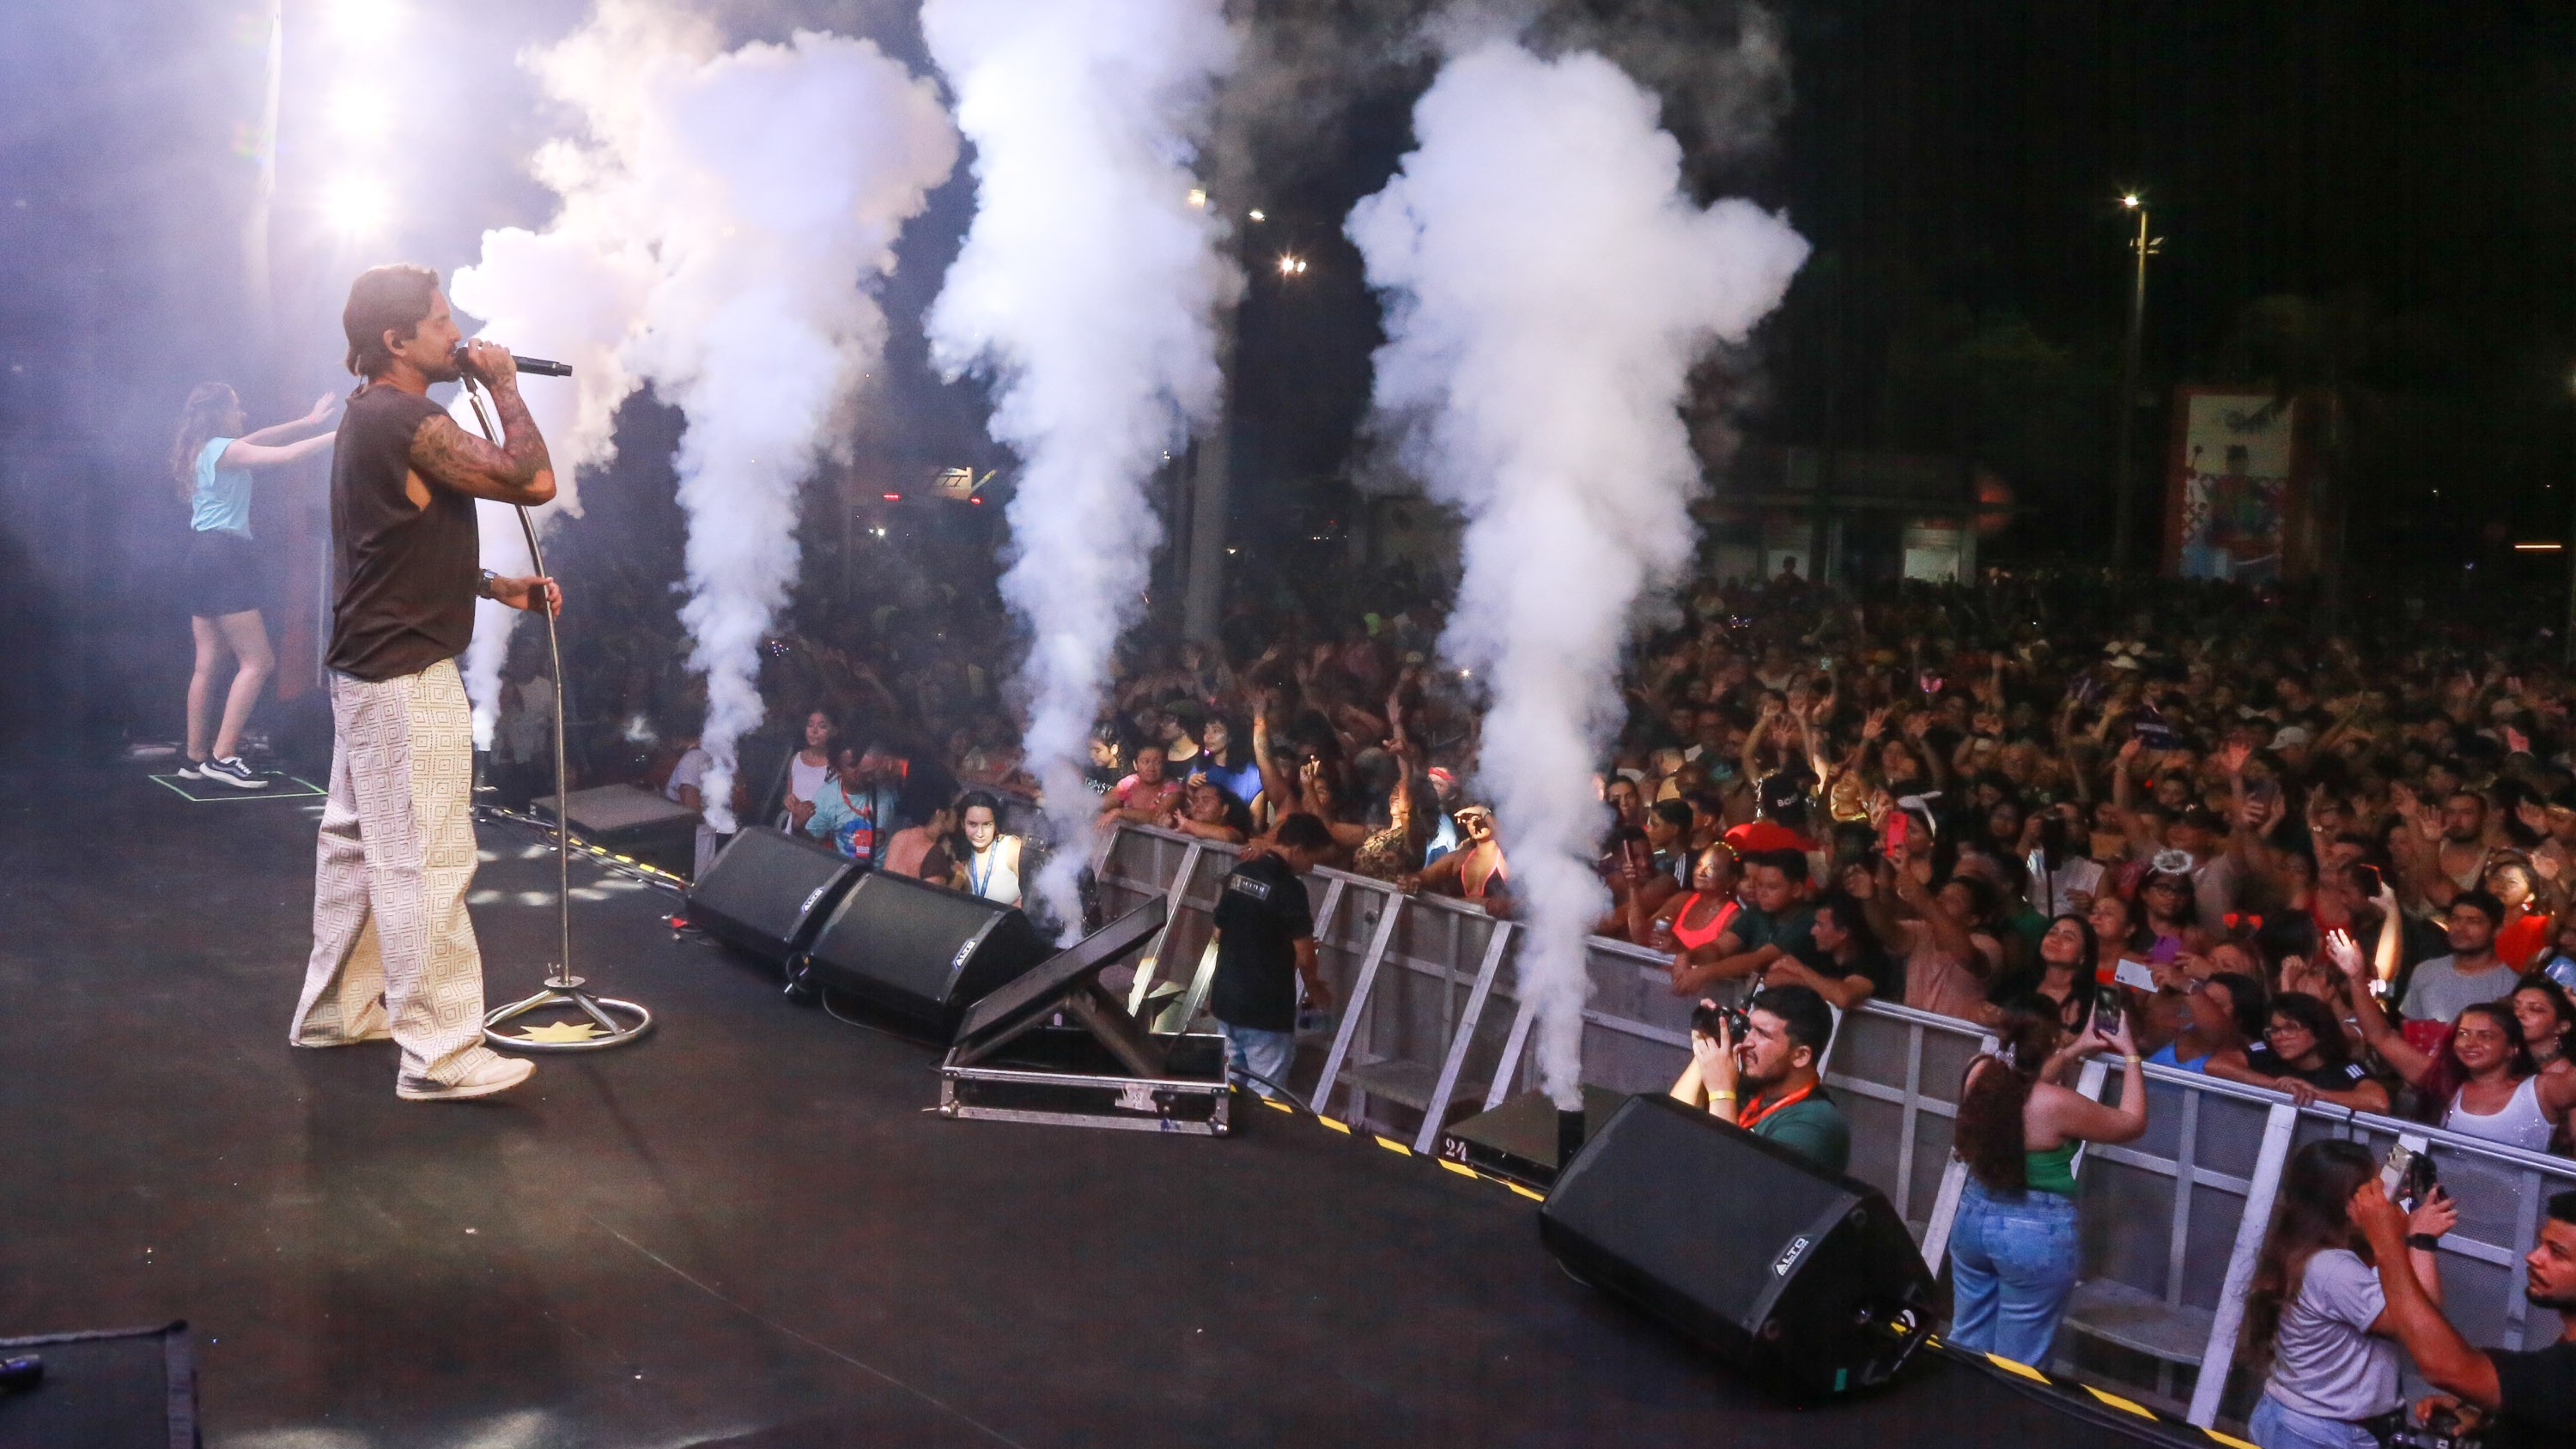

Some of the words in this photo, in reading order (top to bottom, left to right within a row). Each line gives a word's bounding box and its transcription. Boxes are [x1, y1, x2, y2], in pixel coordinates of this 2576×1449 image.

[956, 941, 976, 967] ALTO
[1445, 1137, 1467, 1162] 24
[1776, 1237, 1807, 1275] ALTO
